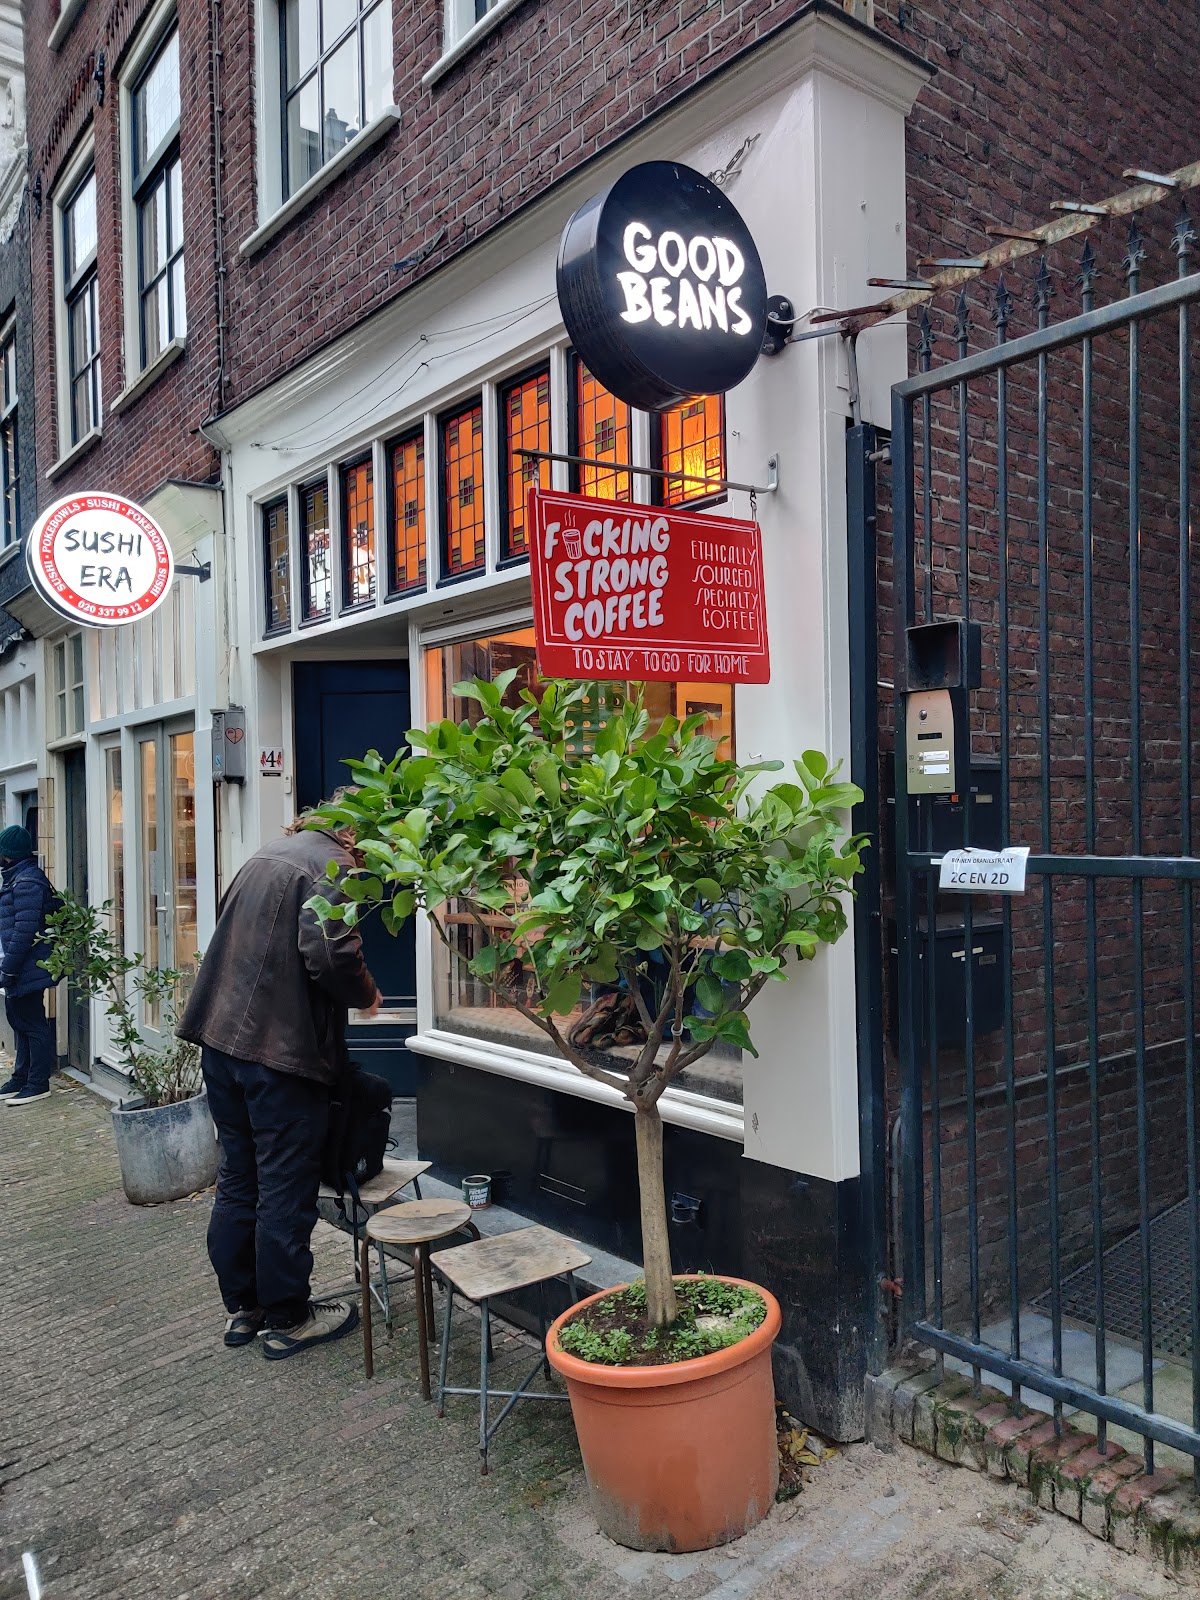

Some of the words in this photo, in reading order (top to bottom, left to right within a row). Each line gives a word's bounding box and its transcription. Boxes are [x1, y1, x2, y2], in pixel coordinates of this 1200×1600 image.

[622, 221, 745, 287] GOOD
[616, 271, 753, 336] BEANS
[87, 499, 120, 511] SUSHI
[42, 502, 81, 554] POKEBOWLS
[126, 508, 167, 564] POKEBOWLS
[64, 529, 142, 557] SUSHI
[691, 540, 756, 566] ETHICALLY
[44, 561, 66, 592] SUSHI
[80, 565, 133, 592] ERA
[150, 567, 167, 597] SUSHI
[554, 554, 670, 602] STRONG
[692, 564, 752, 588] SOURCED
[77, 601, 96, 614] 020
[98, 608, 115, 617] 337
[117, 608, 129, 616] 99
[130, 603, 142, 613] 12
[694, 587, 758, 610] SPECIALTY
[563, 588, 664, 642] COFFEE
[702, 608, 755, 631] COFFEE
[572, 647, 593, 670] TO
[595, 649, 634, 671] STAY
[688, 653, 712, 674] FOR
[714, 654, 750, 675] HOME
[266, 750, 277, 767] 4
[950, 872, 967, 884] 2C
[969, 872, 987, 884] EN
[990, 872, 1009, 884] 2D
